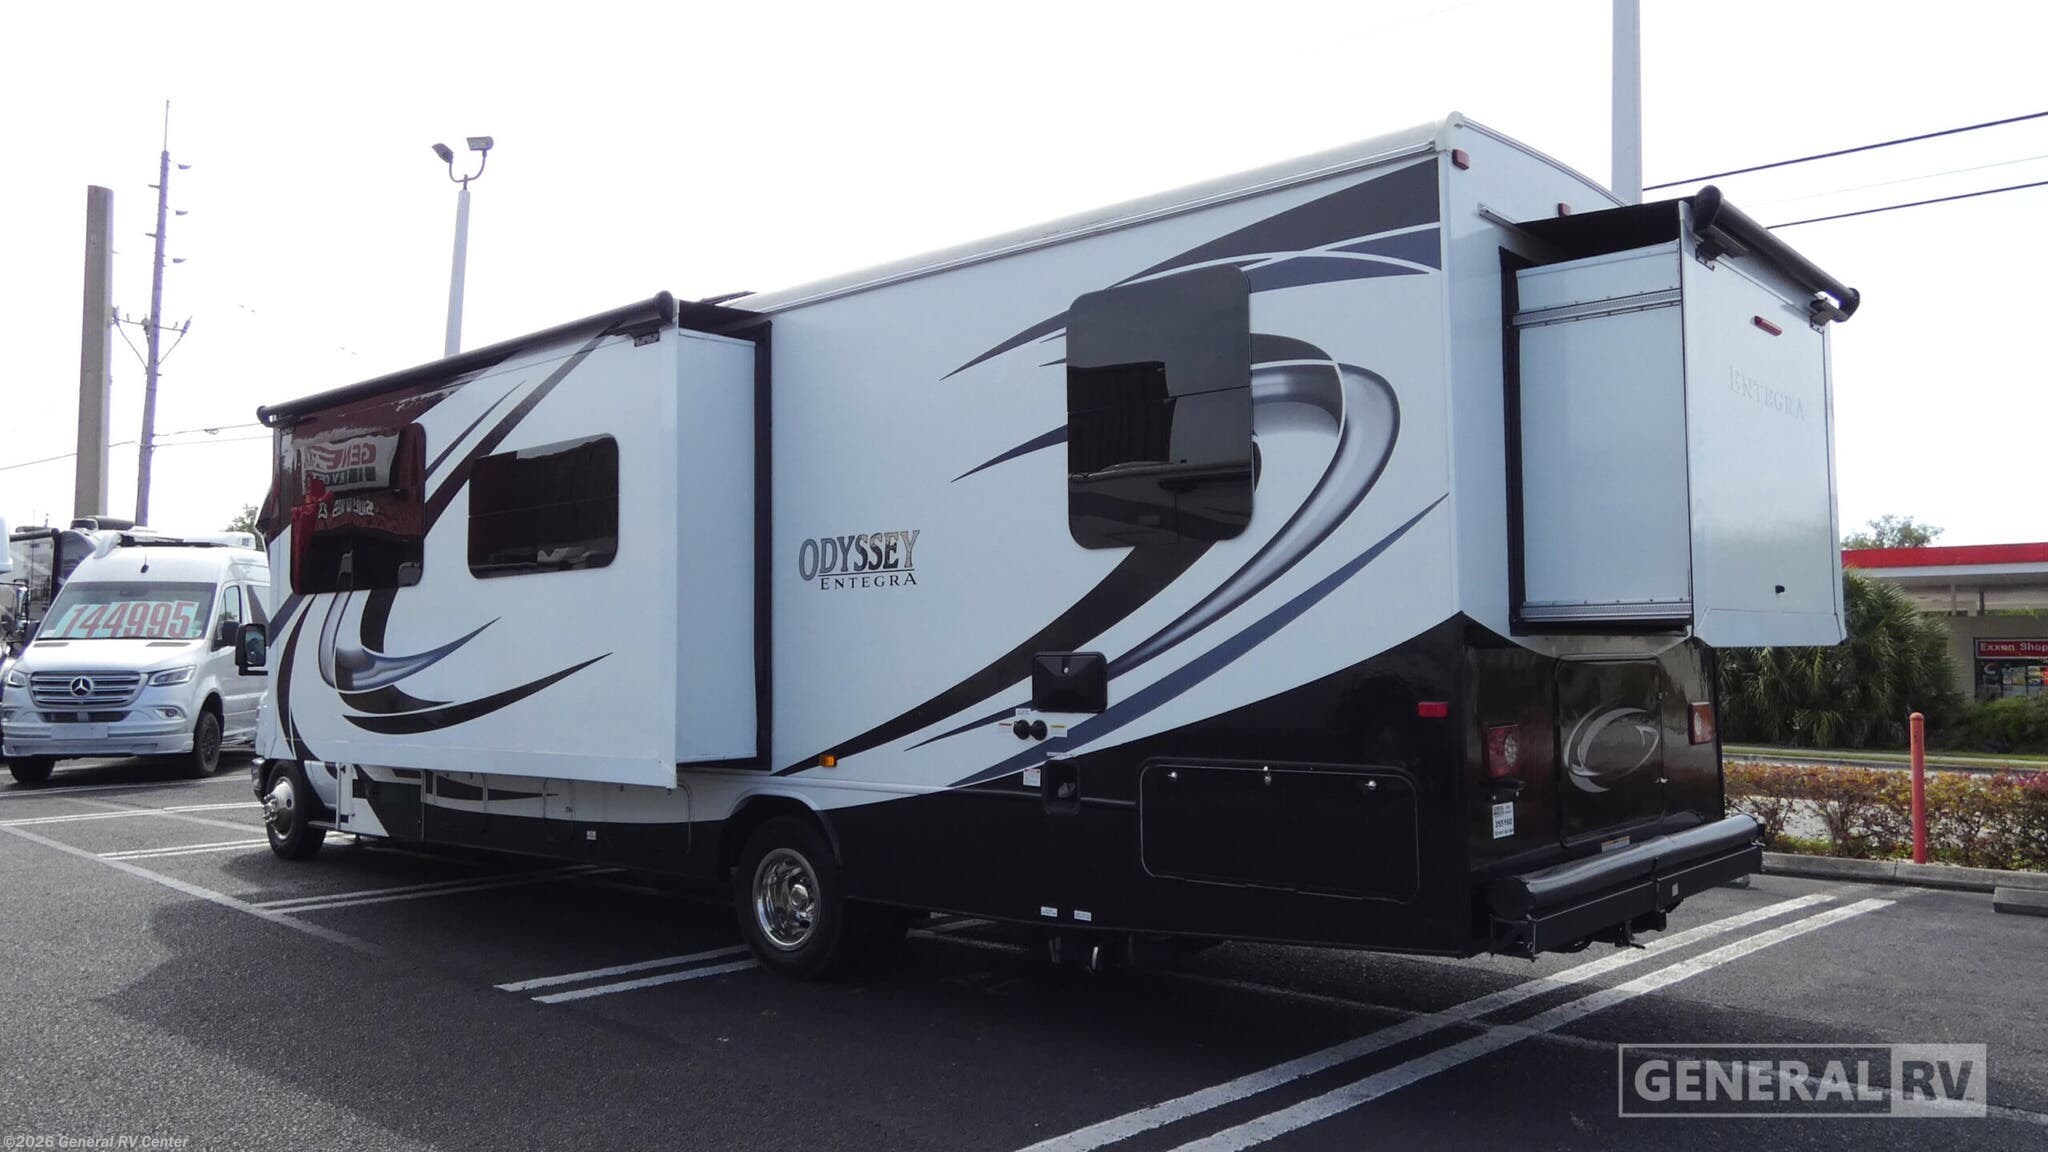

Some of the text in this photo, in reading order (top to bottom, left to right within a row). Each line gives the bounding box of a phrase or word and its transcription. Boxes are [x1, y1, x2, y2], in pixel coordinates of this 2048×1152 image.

[1728, 364, 1805, 421] ENTEGRA
[799, 529, 920, 581] ODYSSEY
[820, 572, 917, 590] ENTEGRA
[62, 602, 195, 638] 144995
[1980, 642, 2015, 652] Exxon
